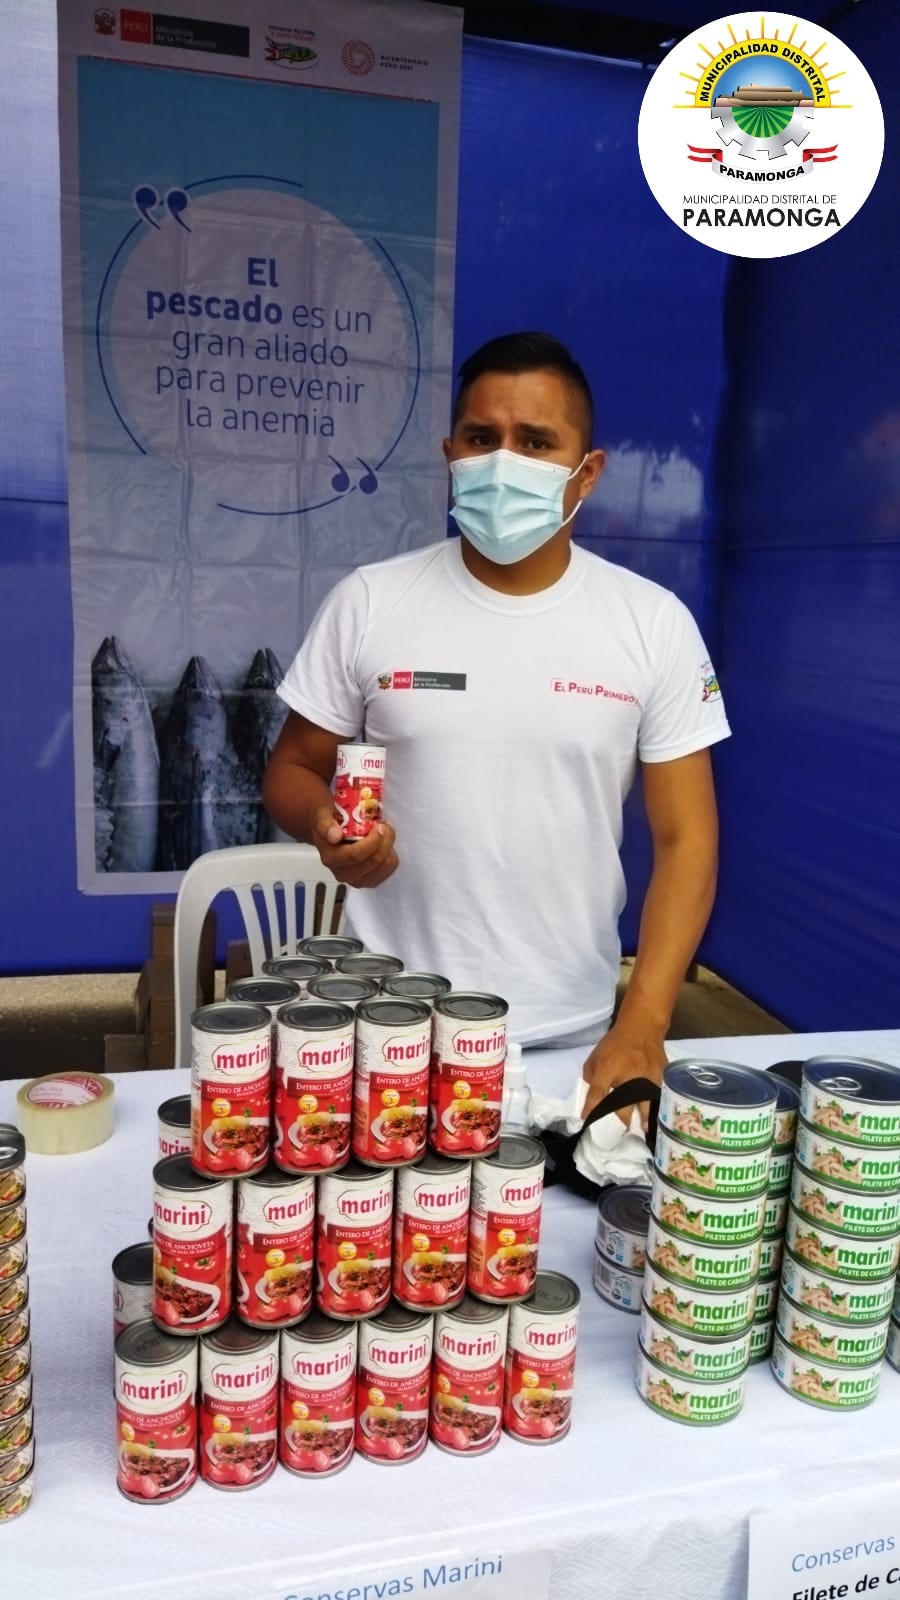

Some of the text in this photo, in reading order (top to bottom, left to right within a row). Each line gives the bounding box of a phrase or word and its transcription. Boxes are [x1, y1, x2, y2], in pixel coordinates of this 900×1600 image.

[380, 55, 429, 66] BICENTENARIO
[247, 257, 279, 288] El
[146, 289, 372, 333] pescado es un
[172, 329, 348, 368] gran aliado
[156, 364, 365, 404] para prevenir
[186, 398, 335, 438] la anemia
[595, 684, 635, 703] PRIMERO
[376, 1076, 401, 1085] ENTERO
[451, 1068, 475, 1078] ENTERO
[476, 1070, 484, 1078] DE
[207, 1084, 241, 1094] ENTERO DE
[296, 1082, 322, 1091] ENTERO
[721, 1138, 742, 1147] FILETE
[861, 1134, 882, 1143] FILETE
[716, 1184, 737, 1193] FILETE
[863, 1179, 882, 1188] FILETE
[154, 1201, 206, 1225] marini
[703, 1204, 759, 1229] marini
[843, 1200, 900, 1221] marini
[408, 1219, 431, 1230] ENTERO
[432, 1223, 441, 1231] DE
[844, 1224, 865, 1233] FILETE
[262, 1235, 298, 1246] ENTERO DE
[335, 1230, 361, 1239] ENTERO
[705, 1232, 726, 1241] FILETE
[173, 1240, 215, 1251] ANCHOVETA
[694, 1250, 752, 1274] marini
[837, 1243, 894, 1266] marini
[838, 1267, 860, 1277] FILETE
[696, 1277, 717, 1286] FILETE
[693, 1295, 749, 1320] marini
[694, 1323, 716, 1332] FILETE
[371, 1337, 427, 1365] marini
[442, 1333, 497, 1357] marini
[296, 1345, 352, 1376] marini
[693, 1340, 747, 1367] marini
[518, 1355, 541, 1369] ENTERO
[215, 1356, 274, 1389] marini
[695, 1371, 716, 1379] FILETE
[123, 1373, 183, 1400] marini
[366, 1373, 389, 1388] ENTERO
[288, 1385, 310, 1400] ENTERO
[210, 1401, 236, 1413] ENTERO
[237, 1405, 245, 1413] DE
[146, 1409, 186, 1424] ANCHOVETA
[691, 1412, 711, 1420] FILETE
[792, 1536, 896, 1573] Conservas
[423, 1556, 503, 1589] Marini
[855, 1574, 880, 1593] de
